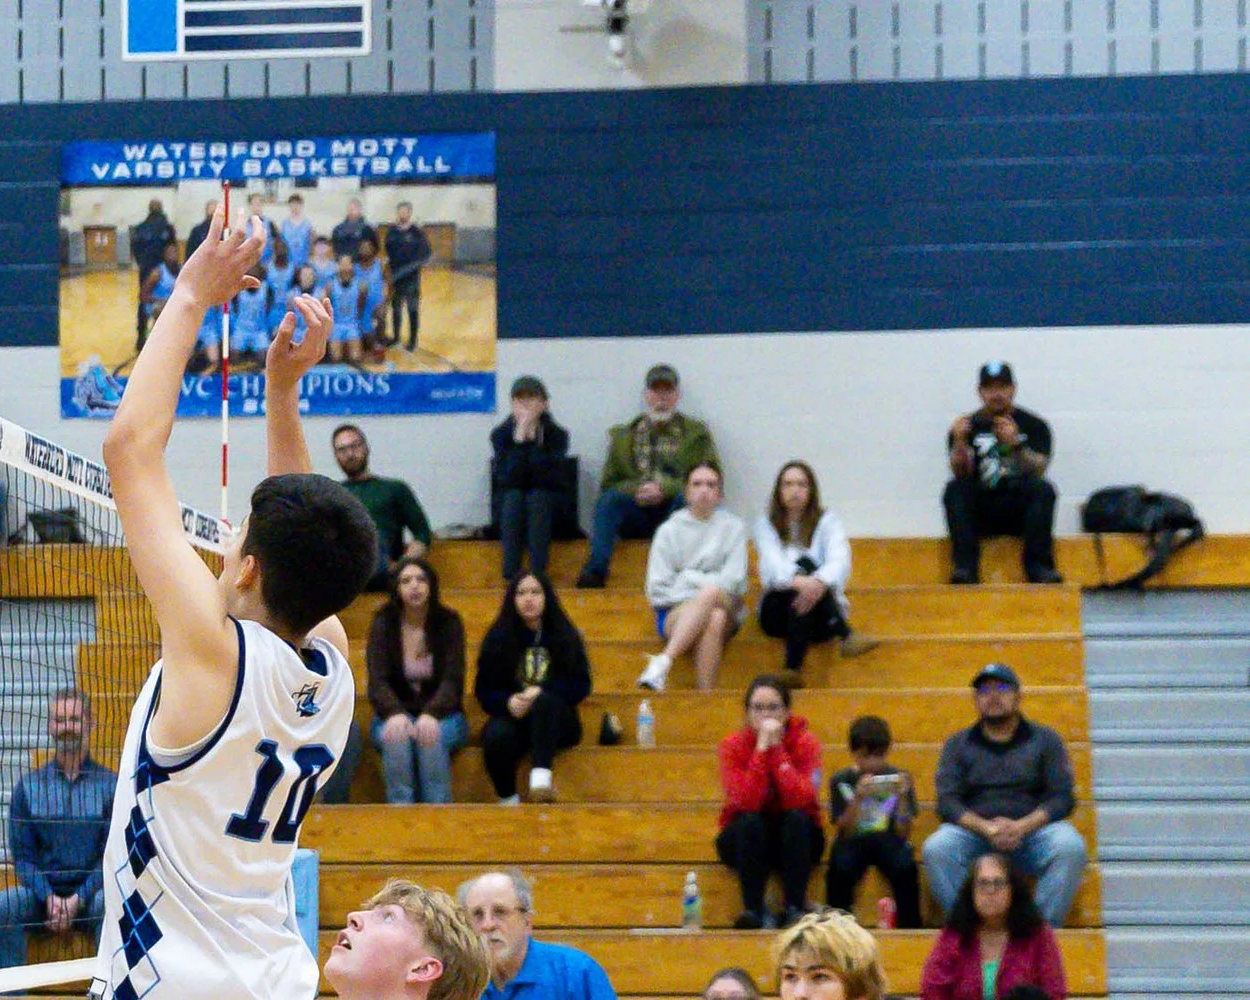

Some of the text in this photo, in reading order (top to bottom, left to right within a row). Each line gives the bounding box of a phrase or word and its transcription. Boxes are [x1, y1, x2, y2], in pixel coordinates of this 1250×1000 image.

[123, 137, 419, 161] WATERFORD MOTT
[91, 155, 451, 180] VARSITY BASKETBALL
[227, 373, 391, 397] CHPIONS
[225, 738, 336, 844] 10
